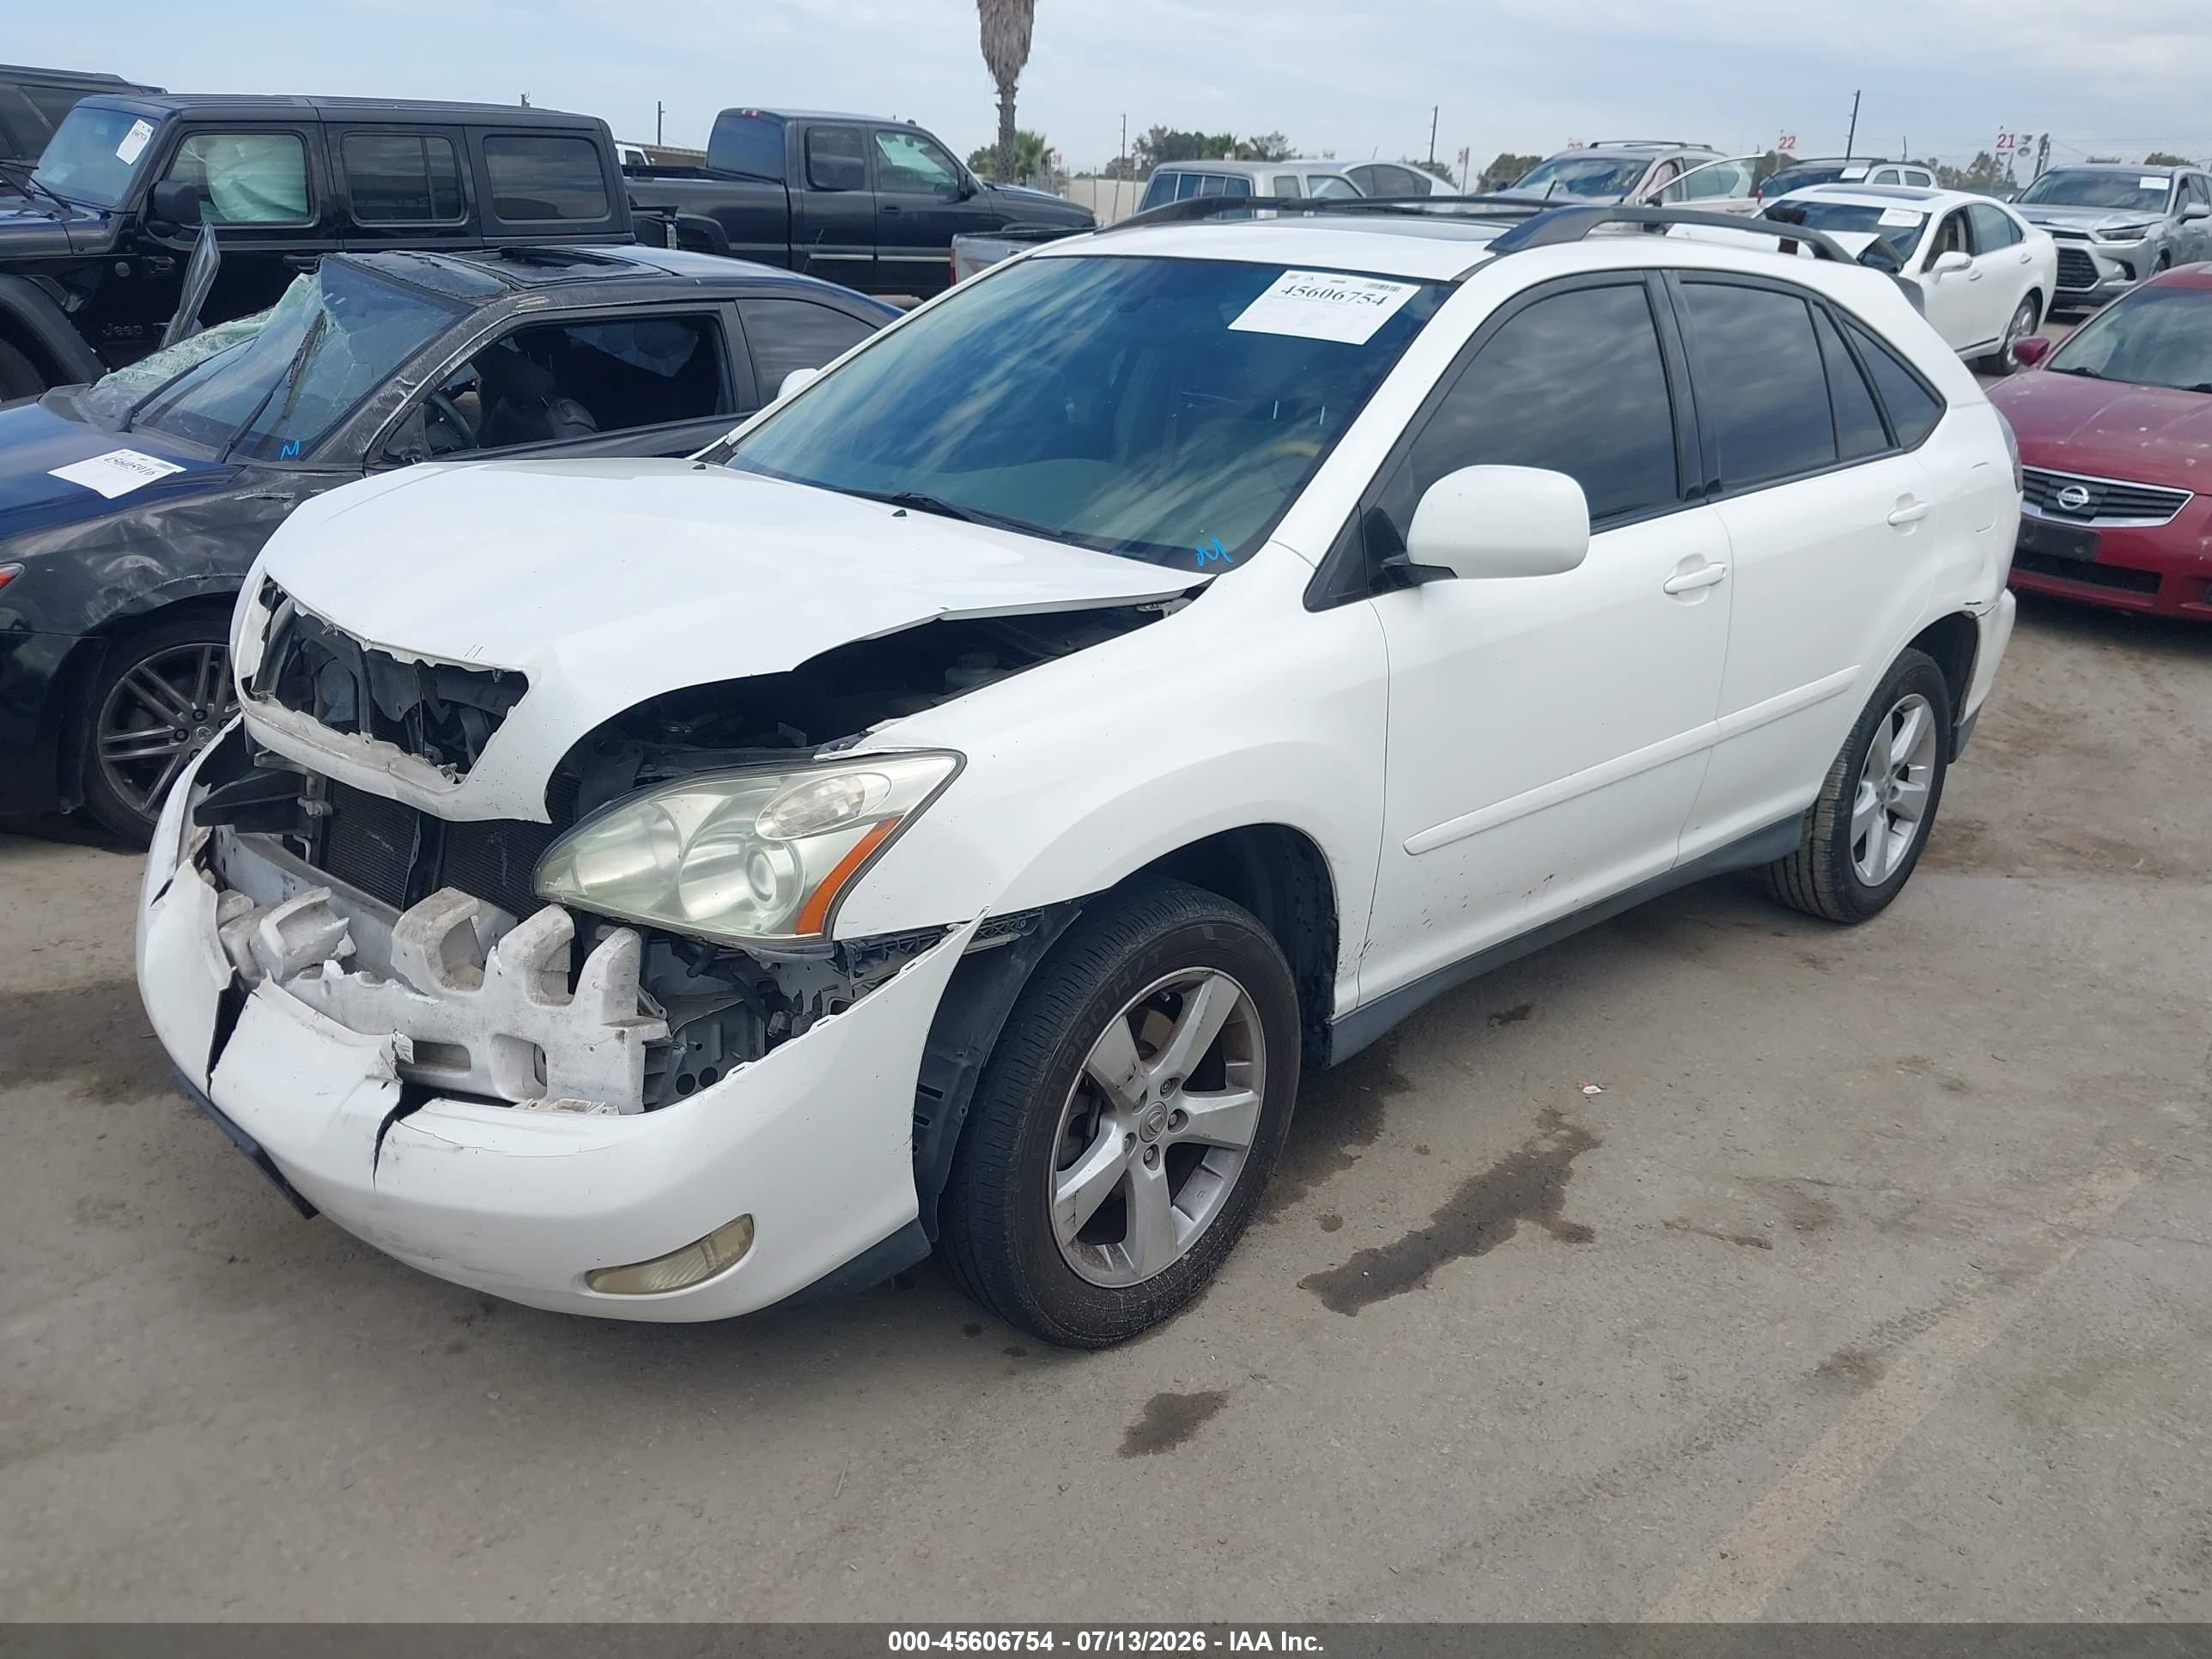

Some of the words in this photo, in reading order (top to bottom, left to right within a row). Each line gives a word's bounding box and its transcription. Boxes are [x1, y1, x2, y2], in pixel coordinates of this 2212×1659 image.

[1779, 136, 1796, 149] 22
[1996, 133, 2014, 149] 21
[1280, 284, 1389, 307] 45606754
